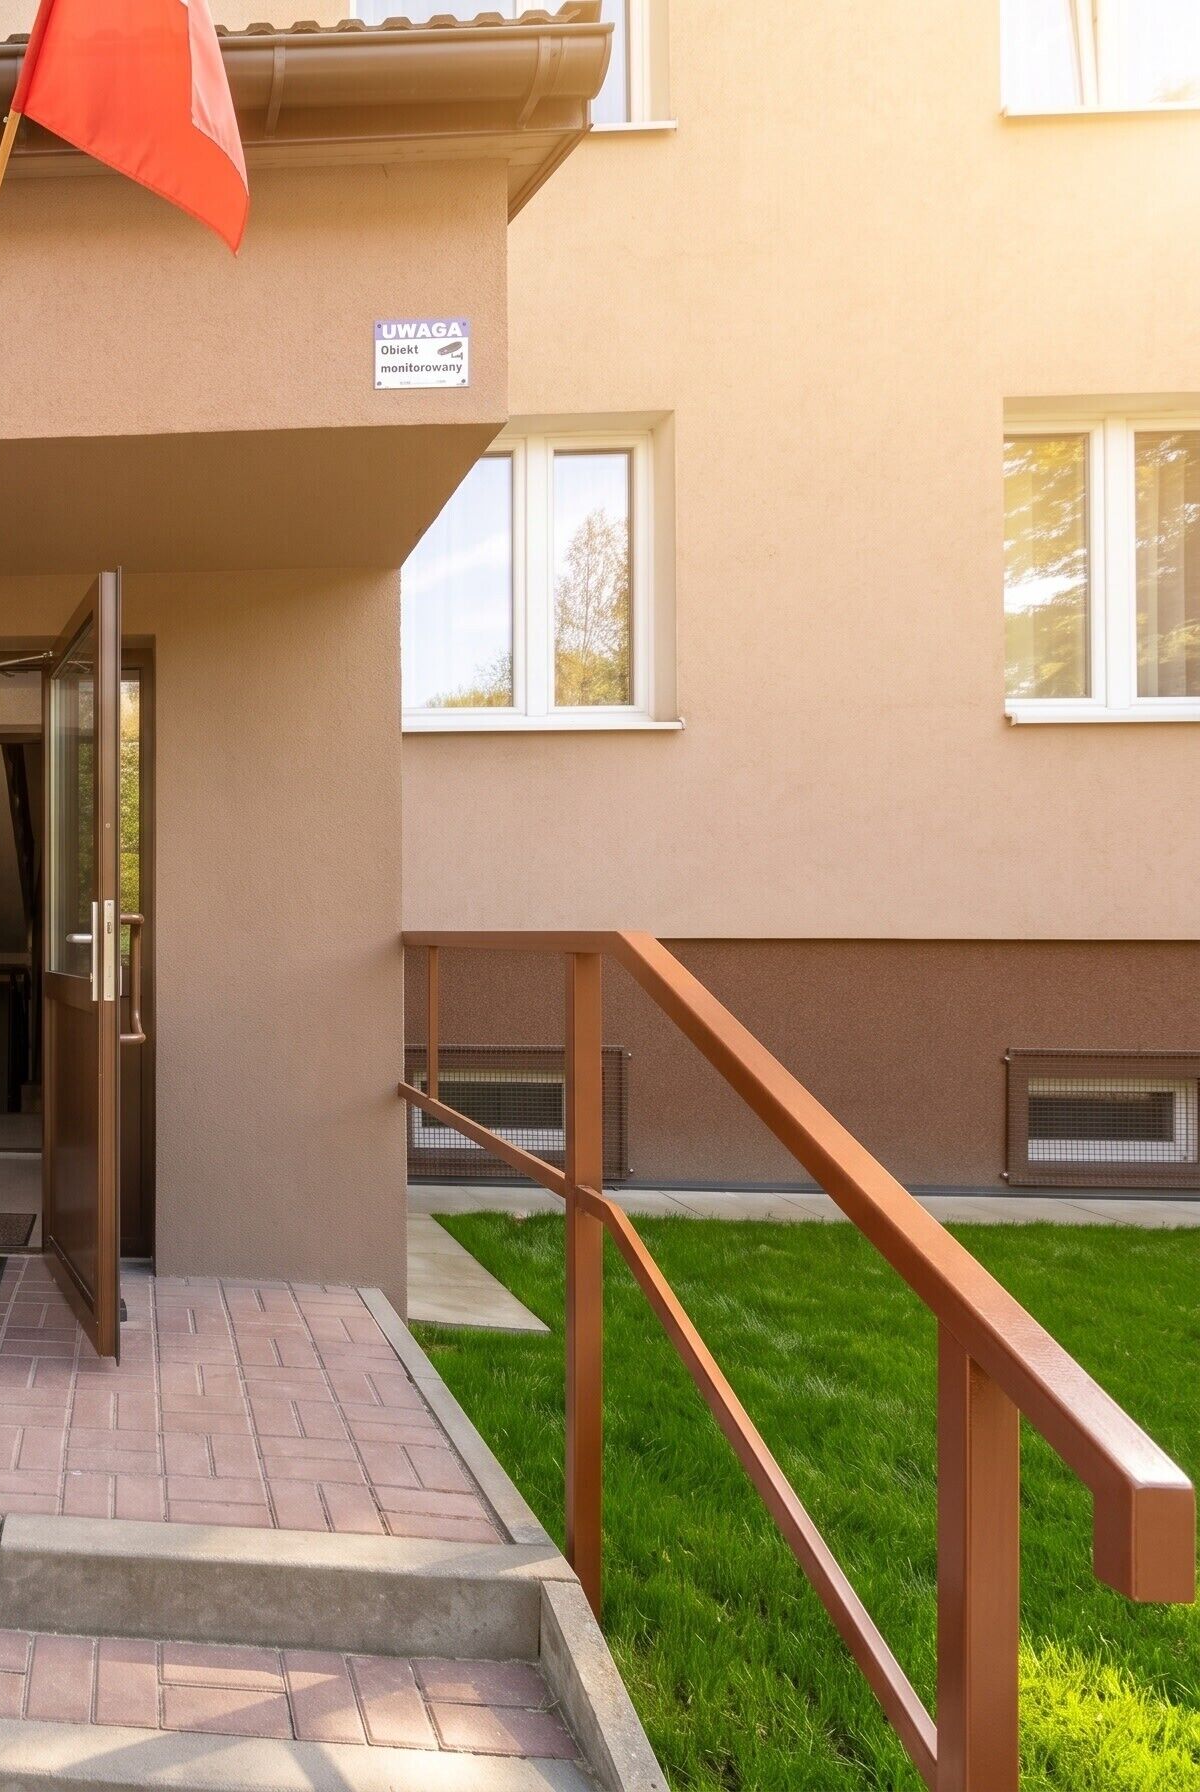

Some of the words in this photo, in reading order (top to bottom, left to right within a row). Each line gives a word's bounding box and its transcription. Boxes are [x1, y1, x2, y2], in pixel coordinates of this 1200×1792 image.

[382, 322, 462, 339] UWAGA
[381, 345, 419, 355] Obiekt
[381, 362, 462, 374] monitorowany
